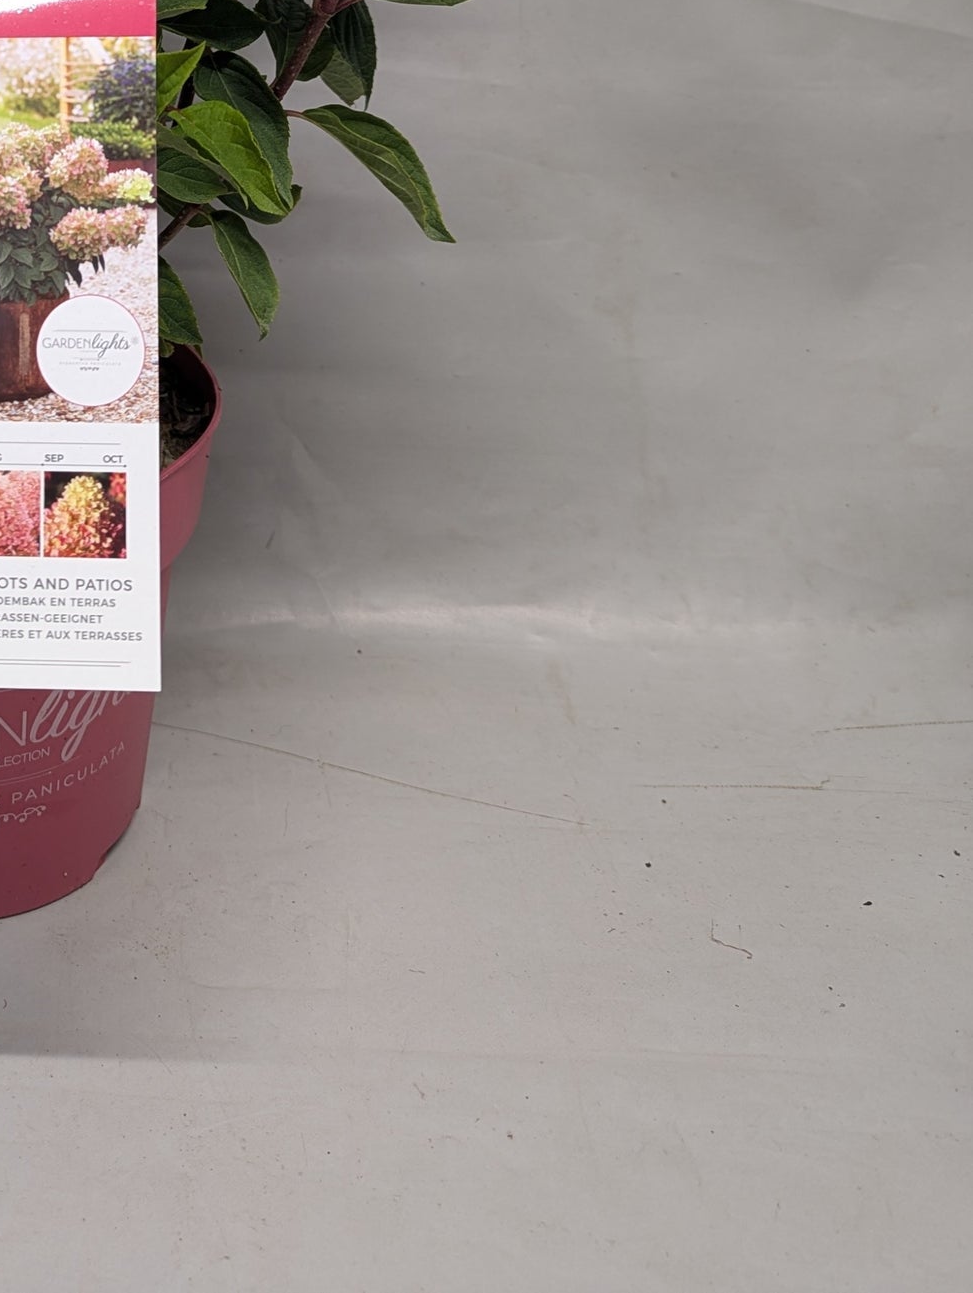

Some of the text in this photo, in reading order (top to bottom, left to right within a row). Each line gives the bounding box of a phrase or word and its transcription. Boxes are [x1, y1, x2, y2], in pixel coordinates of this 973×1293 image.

[43, 453, 65, 464] SEP
[102, 454, 124, 465] OCT
[33, 577, 70, 591] AND
[75, 578, 133, 592] PATIOS
[50, 597, 66, 607] EN
[70, 597, 117, 608] TERRAS
[28, 629, 43, 640] ET
[46, 630, 71, 640] AUX
[74, 630, 143, 642] TERRASSES
[11, 741, 126, 804] PANICULATA
